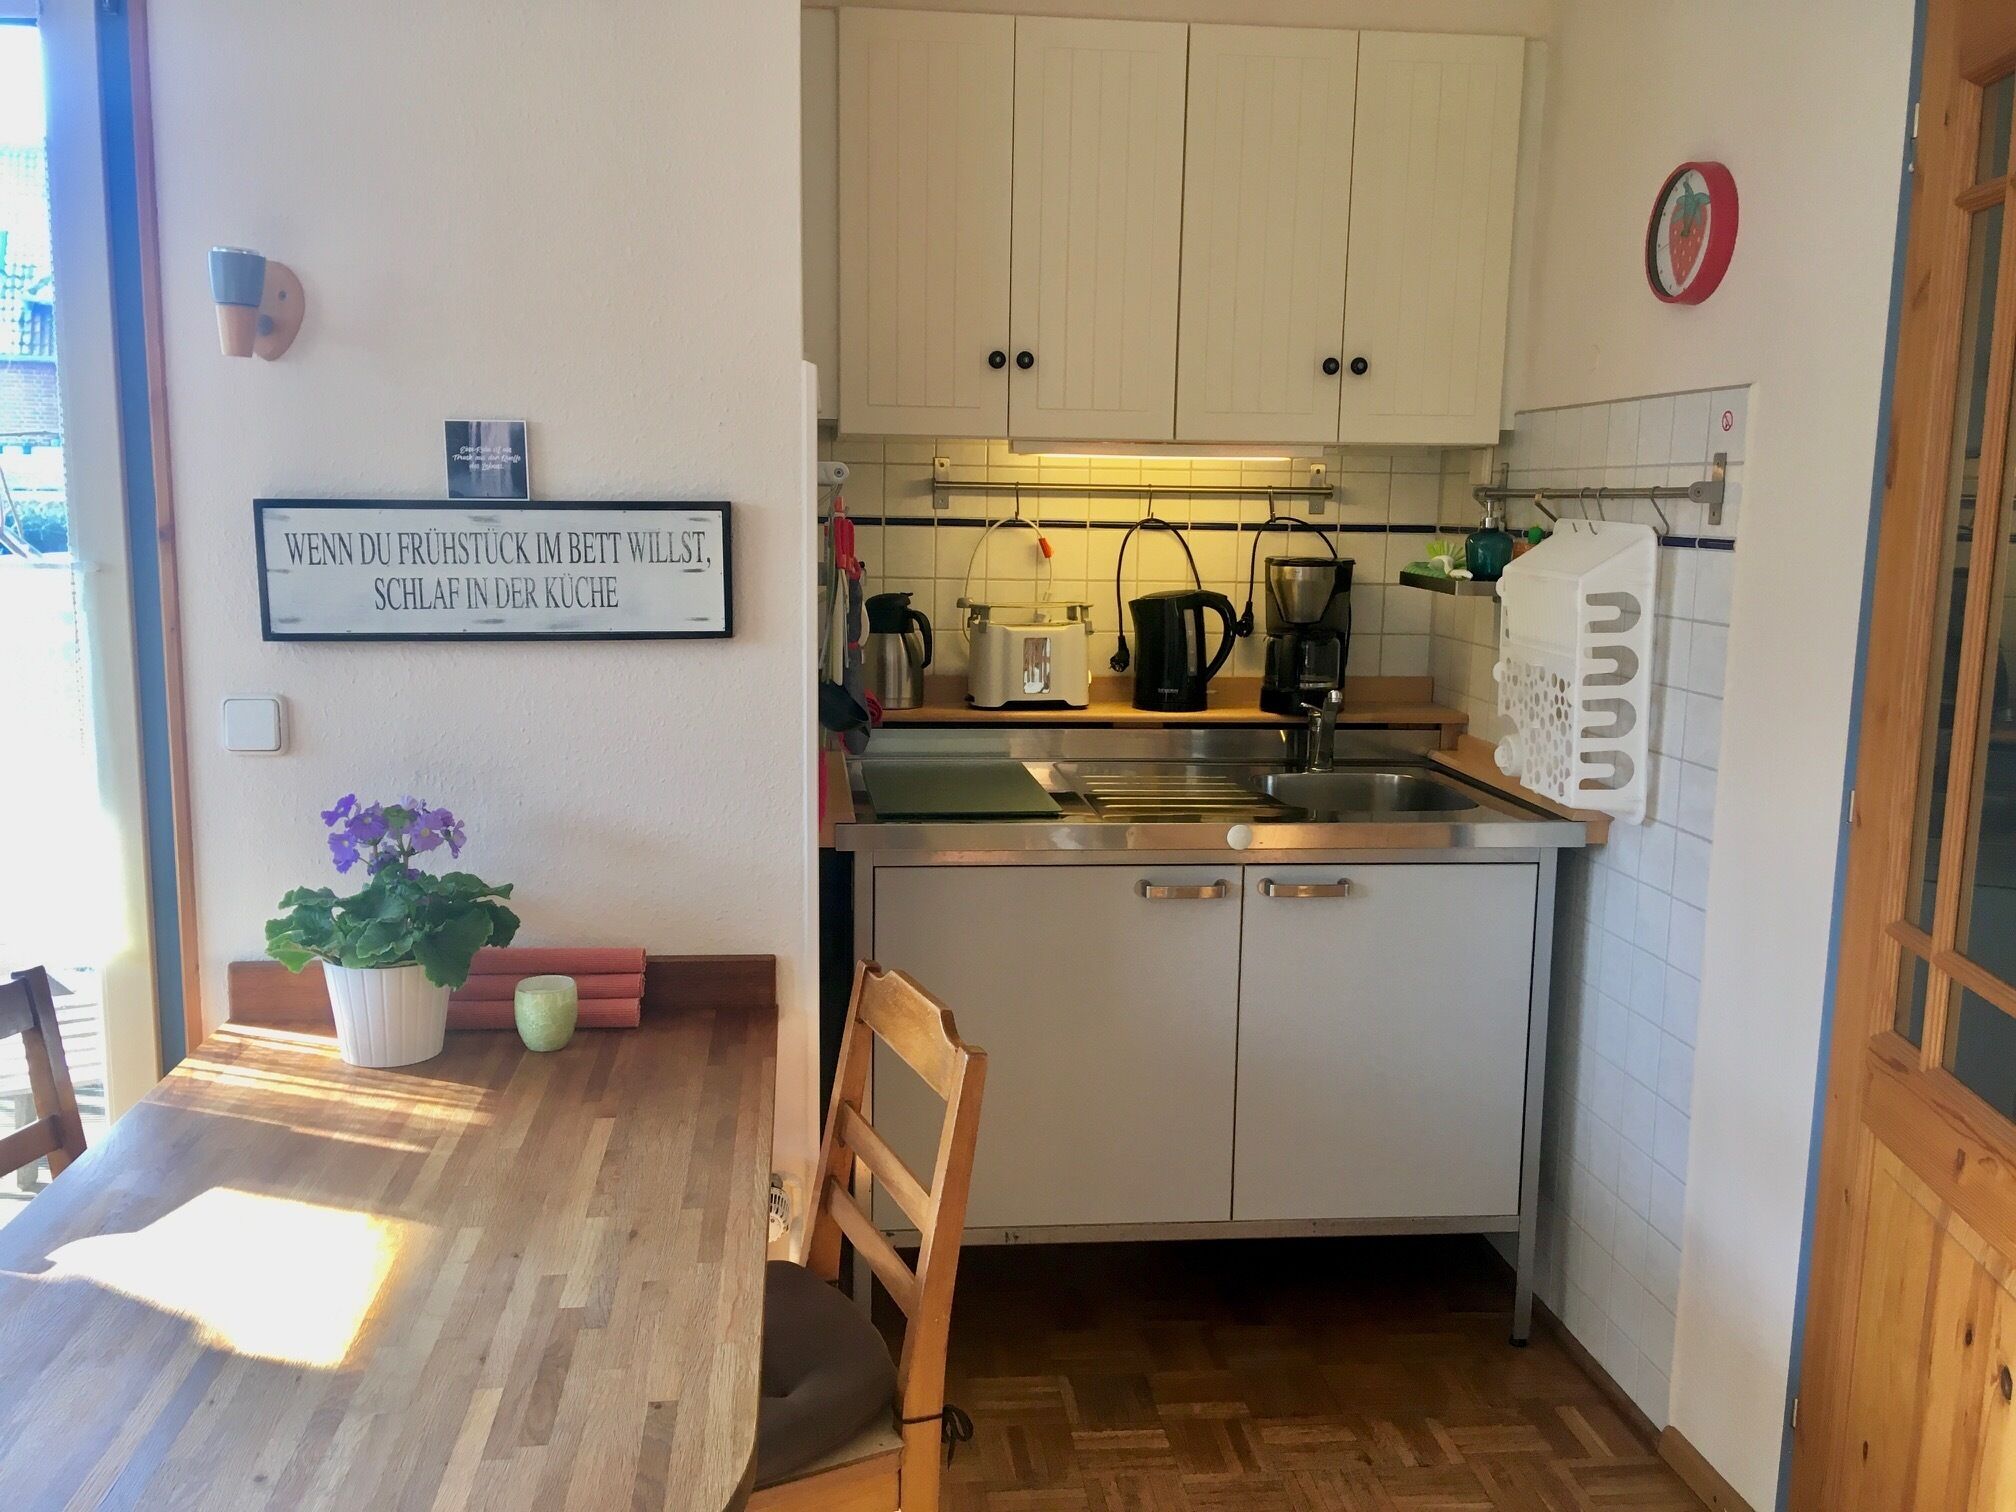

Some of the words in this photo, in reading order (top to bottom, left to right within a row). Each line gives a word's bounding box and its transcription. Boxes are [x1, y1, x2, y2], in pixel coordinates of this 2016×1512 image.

[284, 532, 353, 566] WENN
[358, 532, 391, 566] DU
[397, 527, 531, 566] FRÜHSTÜCK
[535, 531, 563, 565] IM
[567, 531, 622, 565] BETT
[626, 530, 711, 568] WILLST,
[374, 577, 460, 611] SCHLAF
[466, 577, 488, 610] IN
[495, 576, 539, 609] DER
[544, 573, 619, 609] KÜCHE
